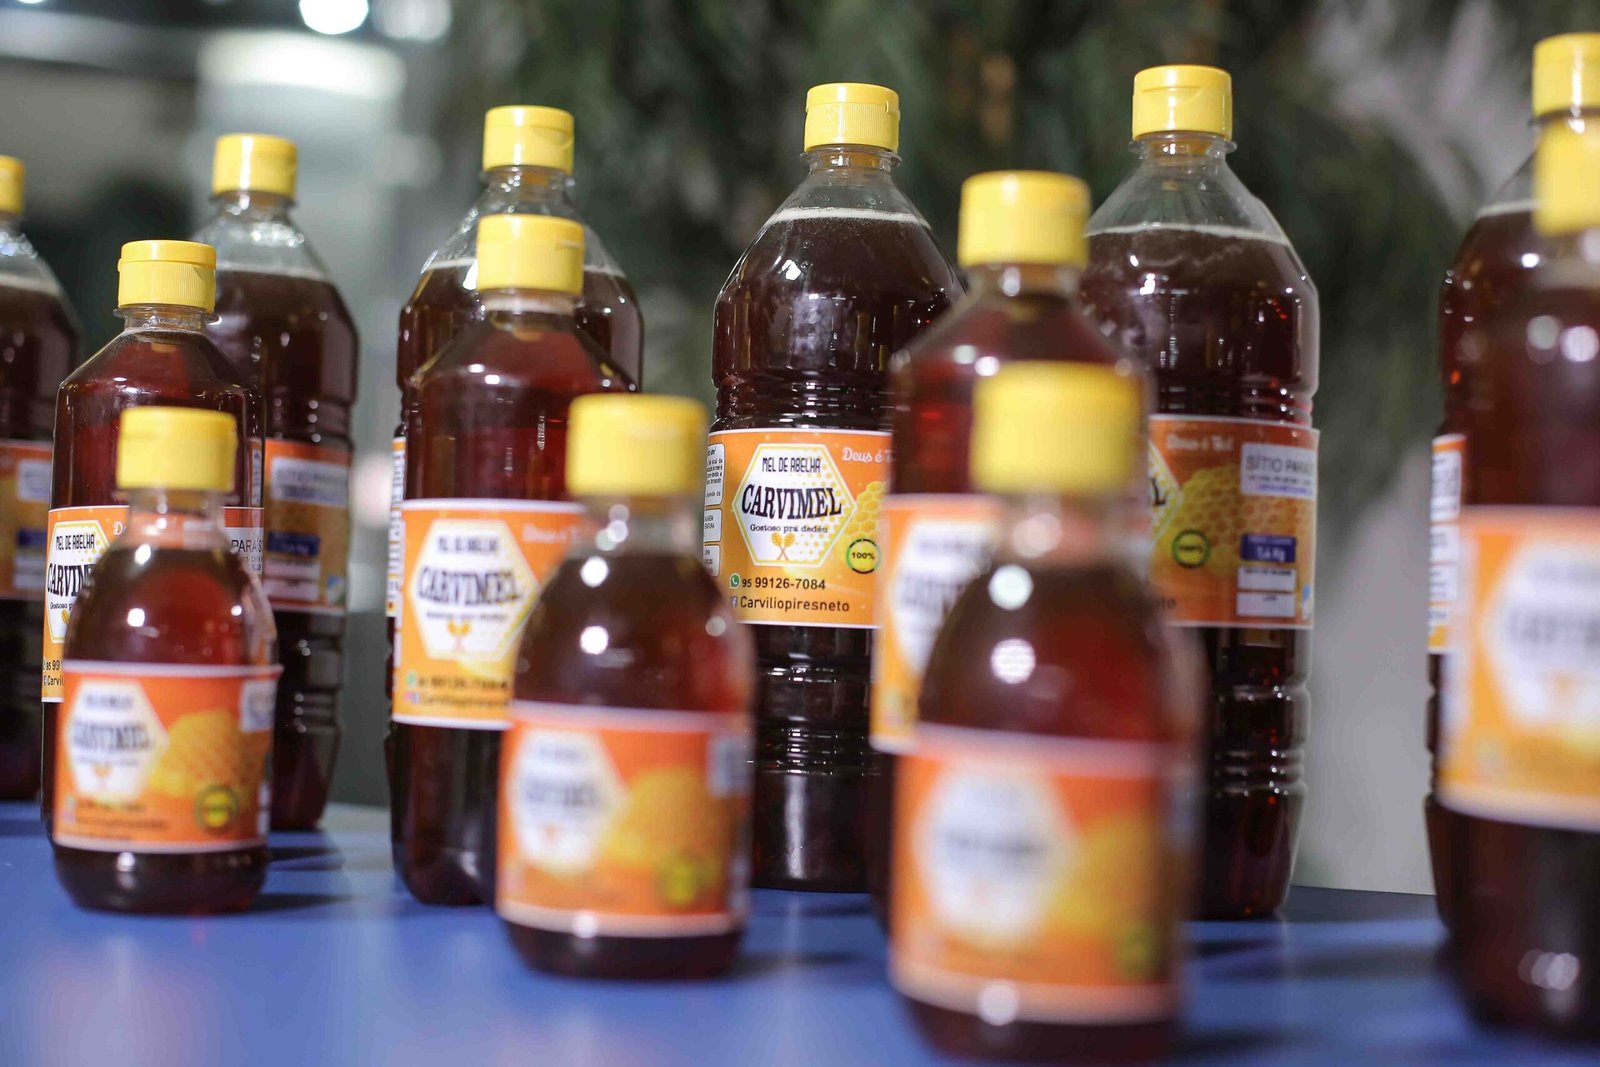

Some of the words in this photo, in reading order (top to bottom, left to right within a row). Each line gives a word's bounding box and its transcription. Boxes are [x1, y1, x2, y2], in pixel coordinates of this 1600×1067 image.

[842, 447, 873, 463] Deus
[762, 457, 776, 472] MEL
[778, 457, 789, 472] DE
[790, 457, 821, 473] ABELHA
[741, 483, 842, 520] CARVIMEL
[750, 524, 781, 533] Gostoso
[56, 536, 64, 551] MEL
[65, 536, 72, 550] DE
[72, 534, 95, 550] ABELHA
[851, 551, 876, 560] 100%
[47, 563, 94, 597] CARVIM
[742, 579, 752, 588] 95
[755, 577, 827, 590] 99126-7084
[740, 596, 850, 612] Carviliopiresneto
